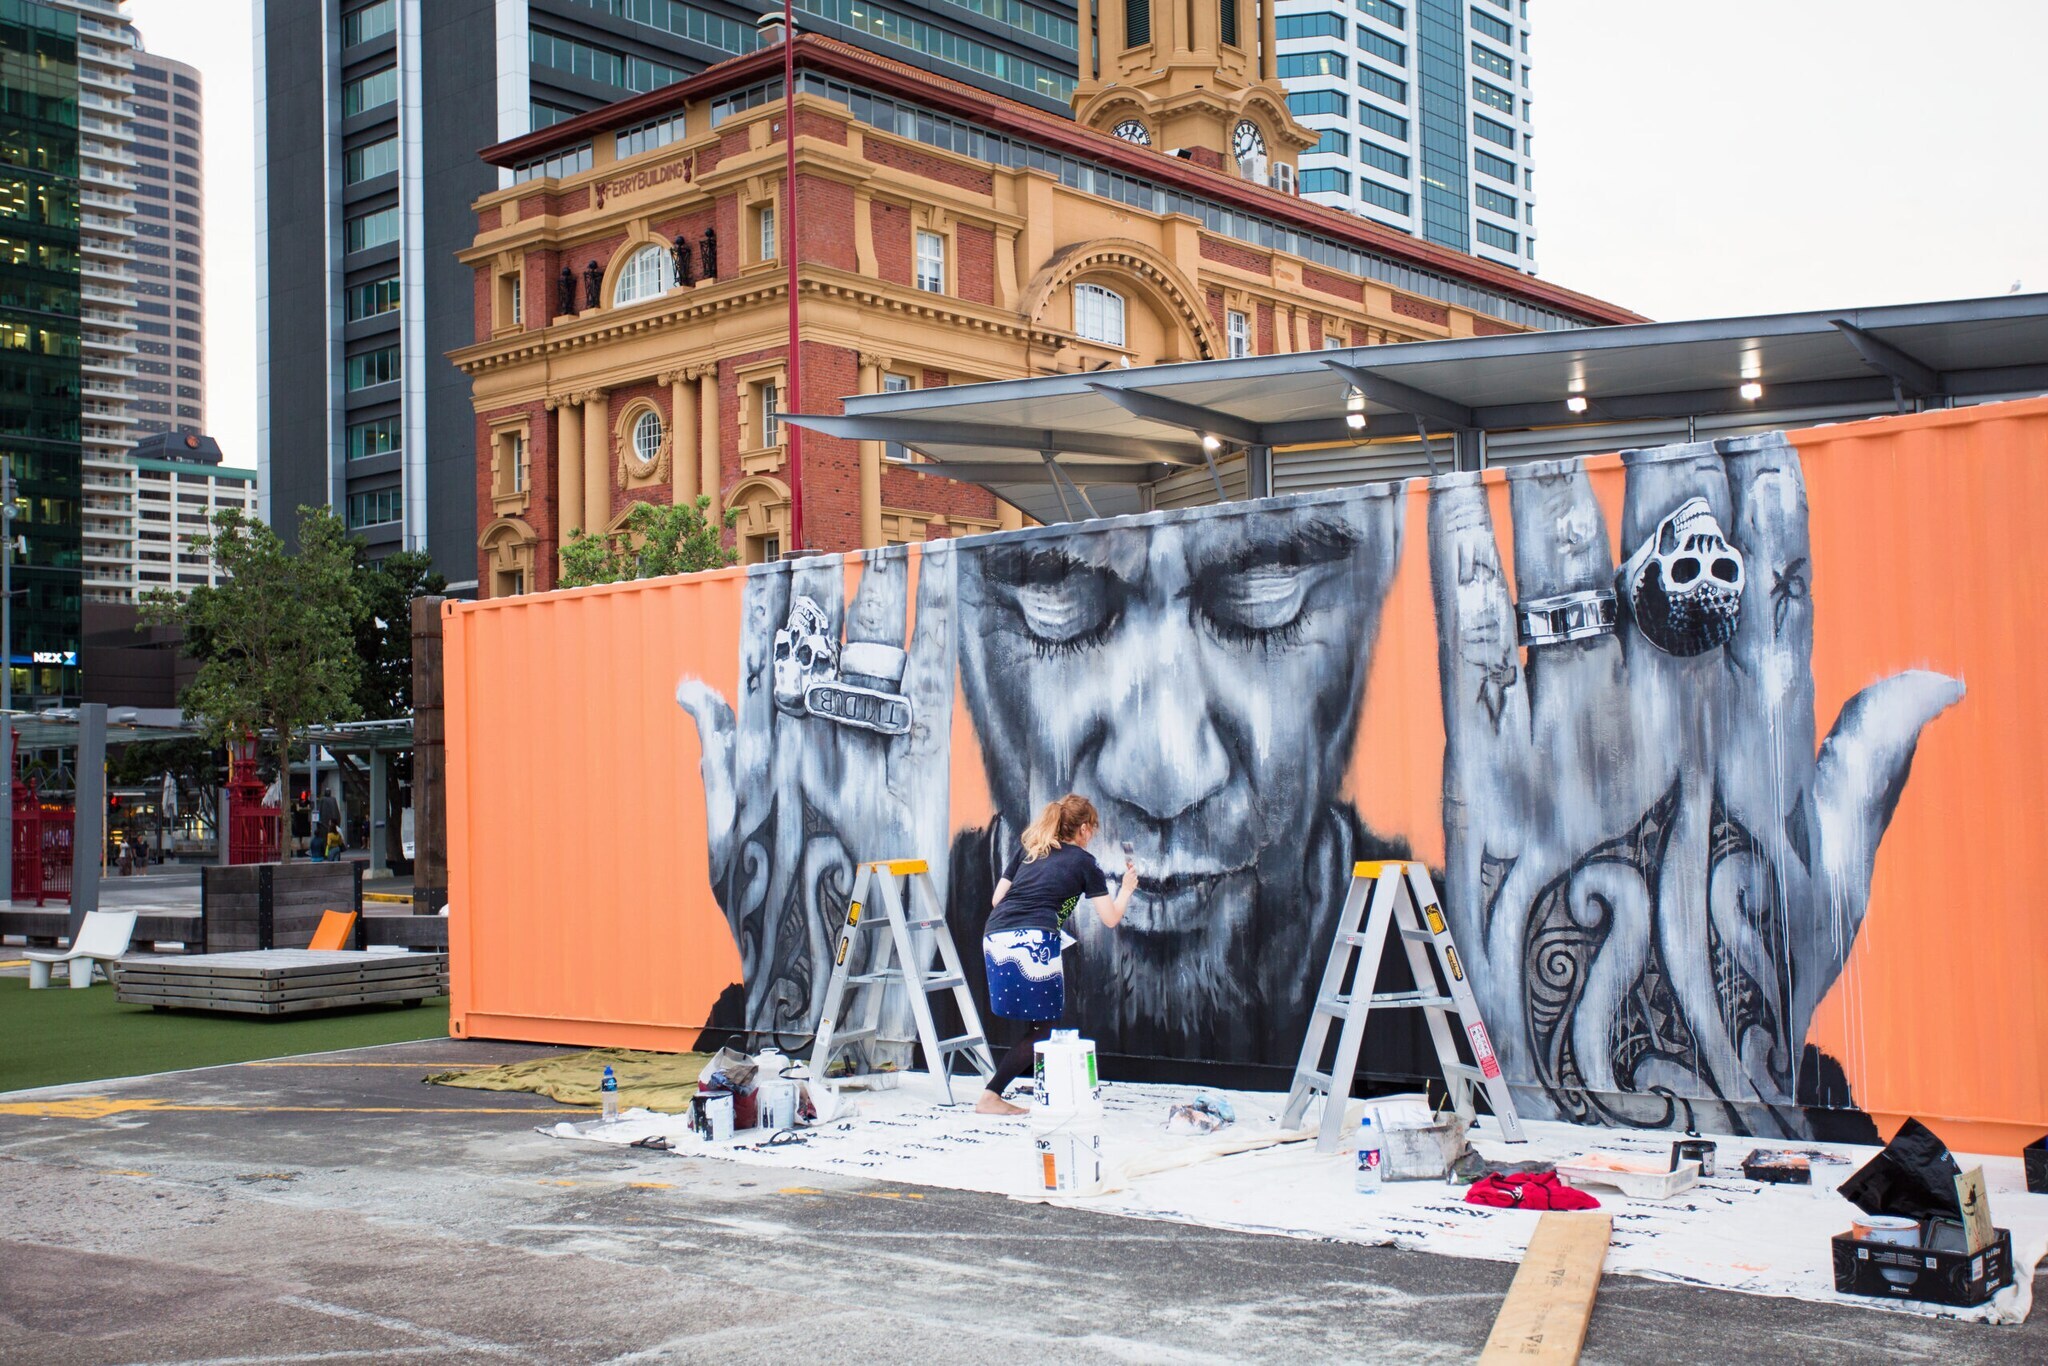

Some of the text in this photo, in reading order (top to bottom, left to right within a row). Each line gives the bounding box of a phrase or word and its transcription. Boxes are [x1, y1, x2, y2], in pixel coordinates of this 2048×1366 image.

[605, 162, 684, 200] FERRY BUILDING
[33, 651, 62, 664] NZX
